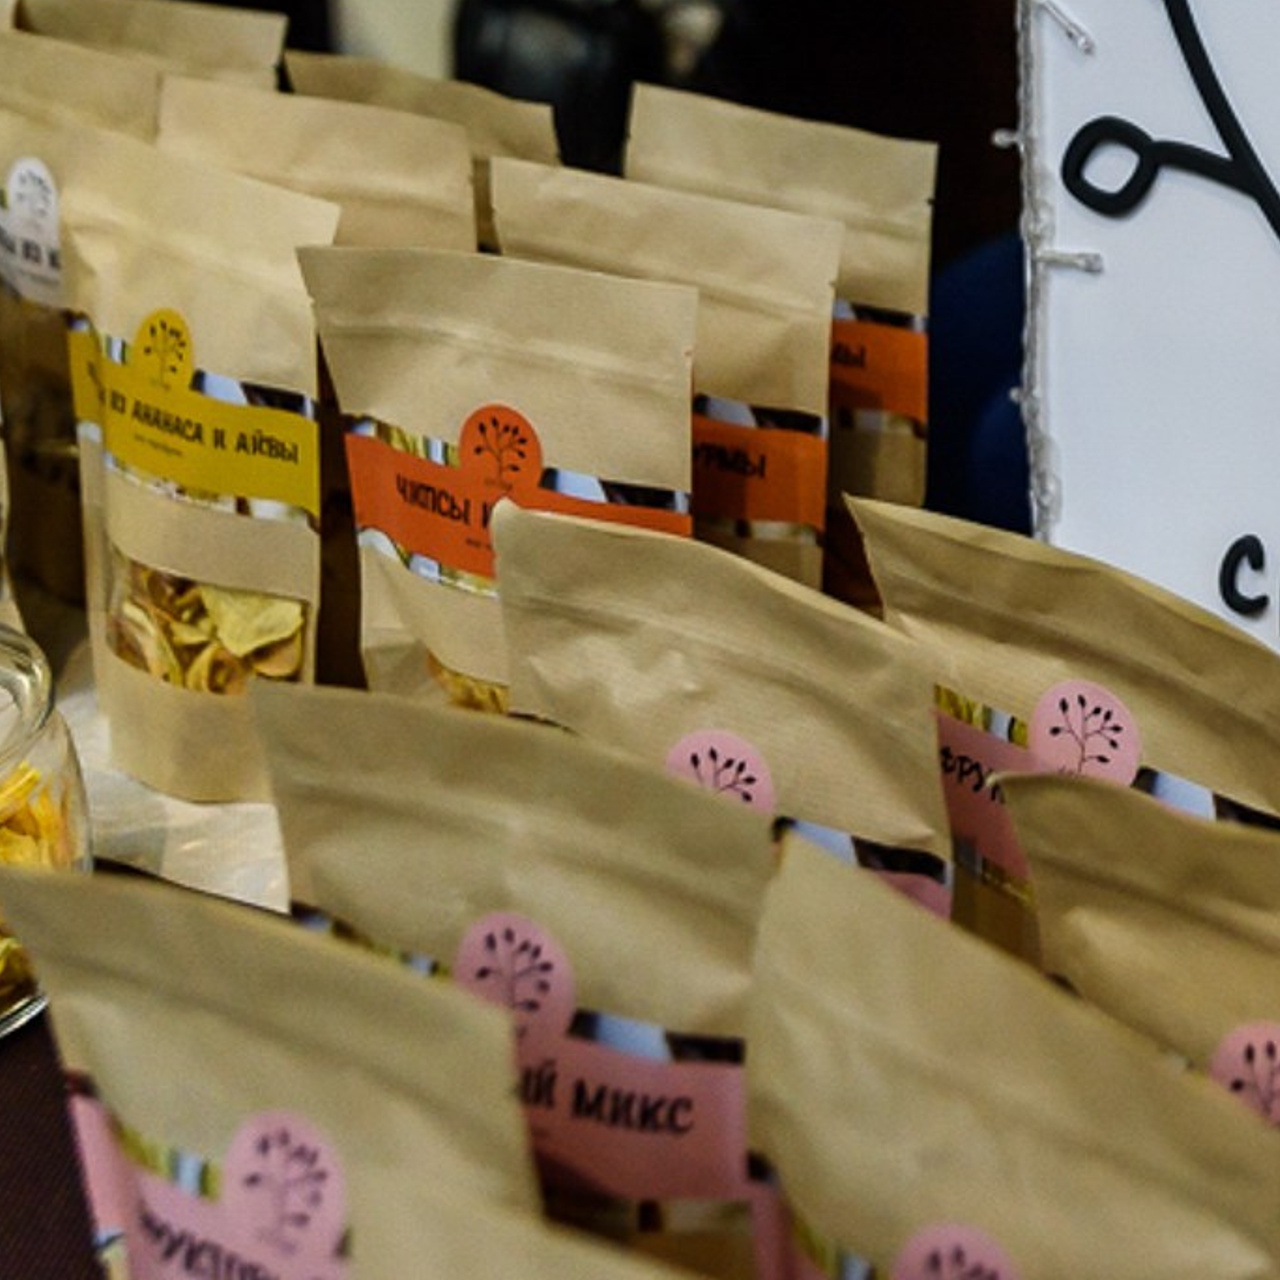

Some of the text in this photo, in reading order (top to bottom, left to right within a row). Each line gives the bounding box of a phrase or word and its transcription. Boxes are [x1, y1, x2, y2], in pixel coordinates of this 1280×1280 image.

[131, 399, 204, 444] АНАНАСА
[235, 428, 299, 465] АЙВЫ
[395, 472, 471, 527] ЧИПСЫ
[571, 1076, 695, 1135] МИКС
